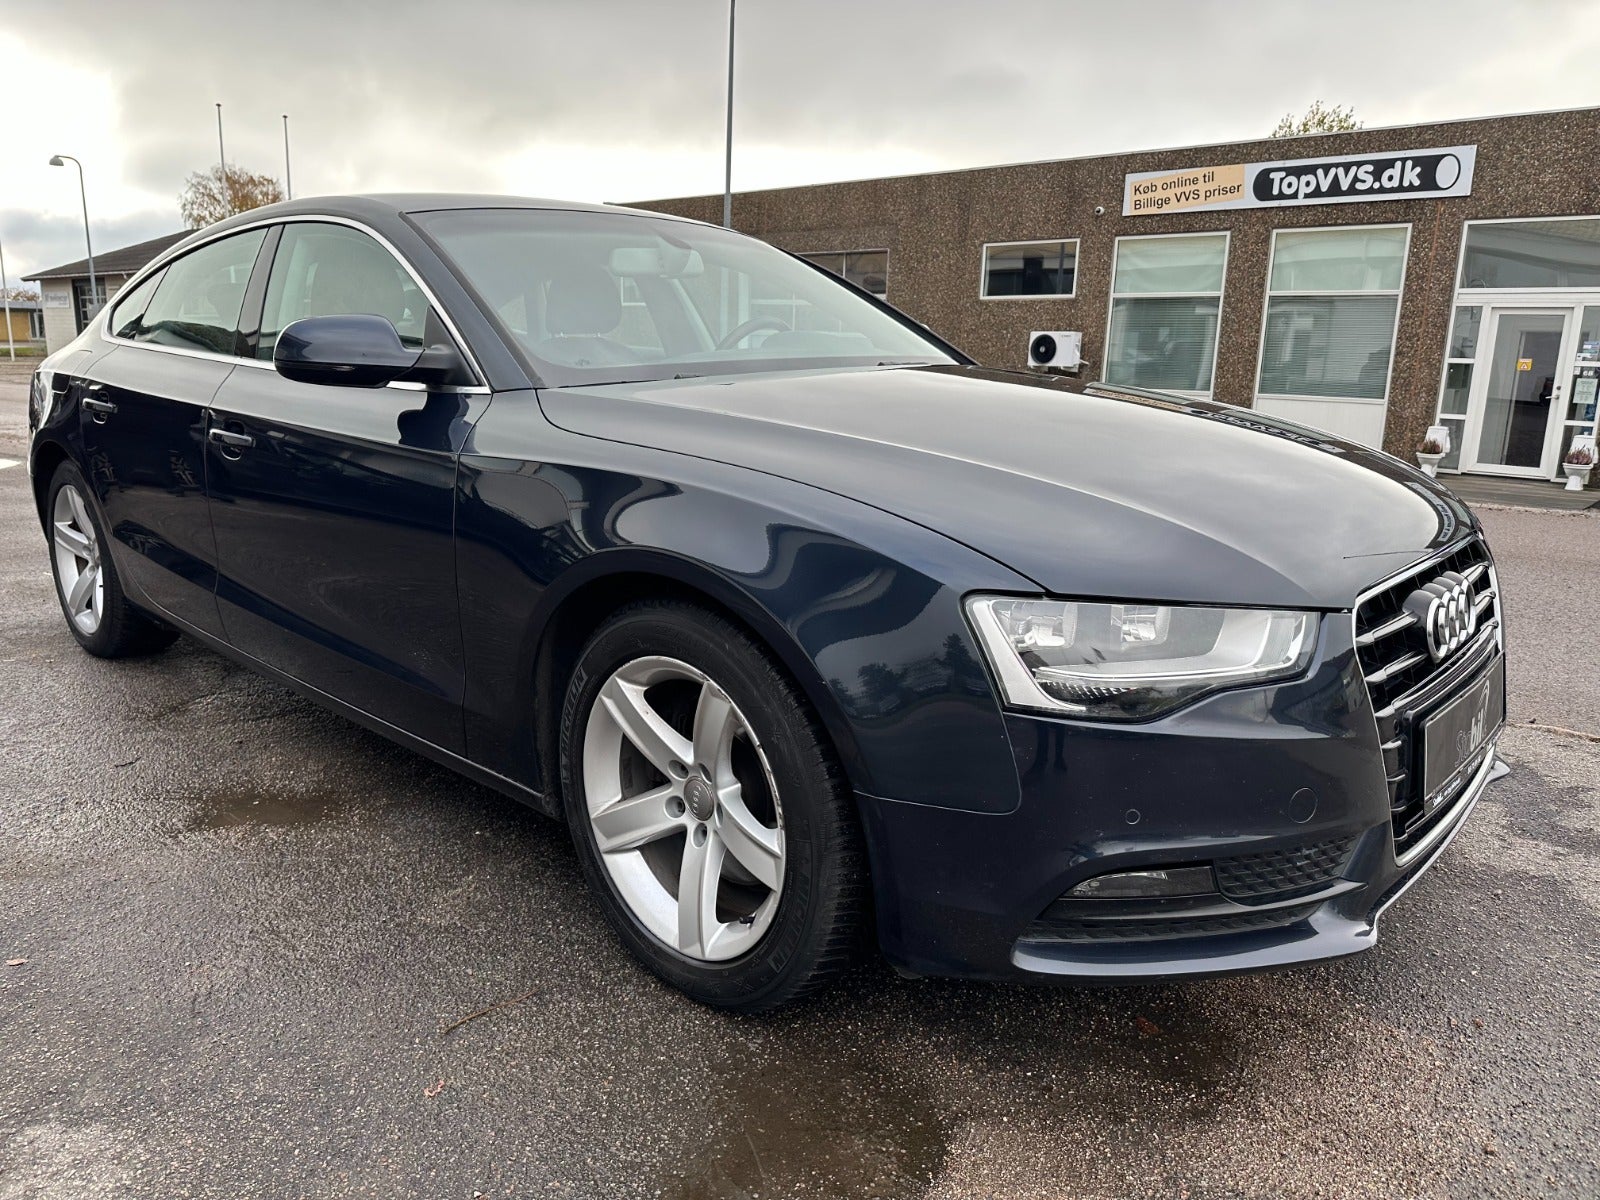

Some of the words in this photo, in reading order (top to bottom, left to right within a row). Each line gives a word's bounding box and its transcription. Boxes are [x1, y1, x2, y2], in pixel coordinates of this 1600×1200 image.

[1134, 184, 1157, 195] Køb
[1161, 176, 1199, 191] online
[1202, 171, 1215, 183] til
[1269, 159, 1422, 199] TopVVS.dk
[1134, 196, 1171, 210] Billige
[1174, 189, 1200, 203] VVS
[1204, 183, 1242, 200] priser
